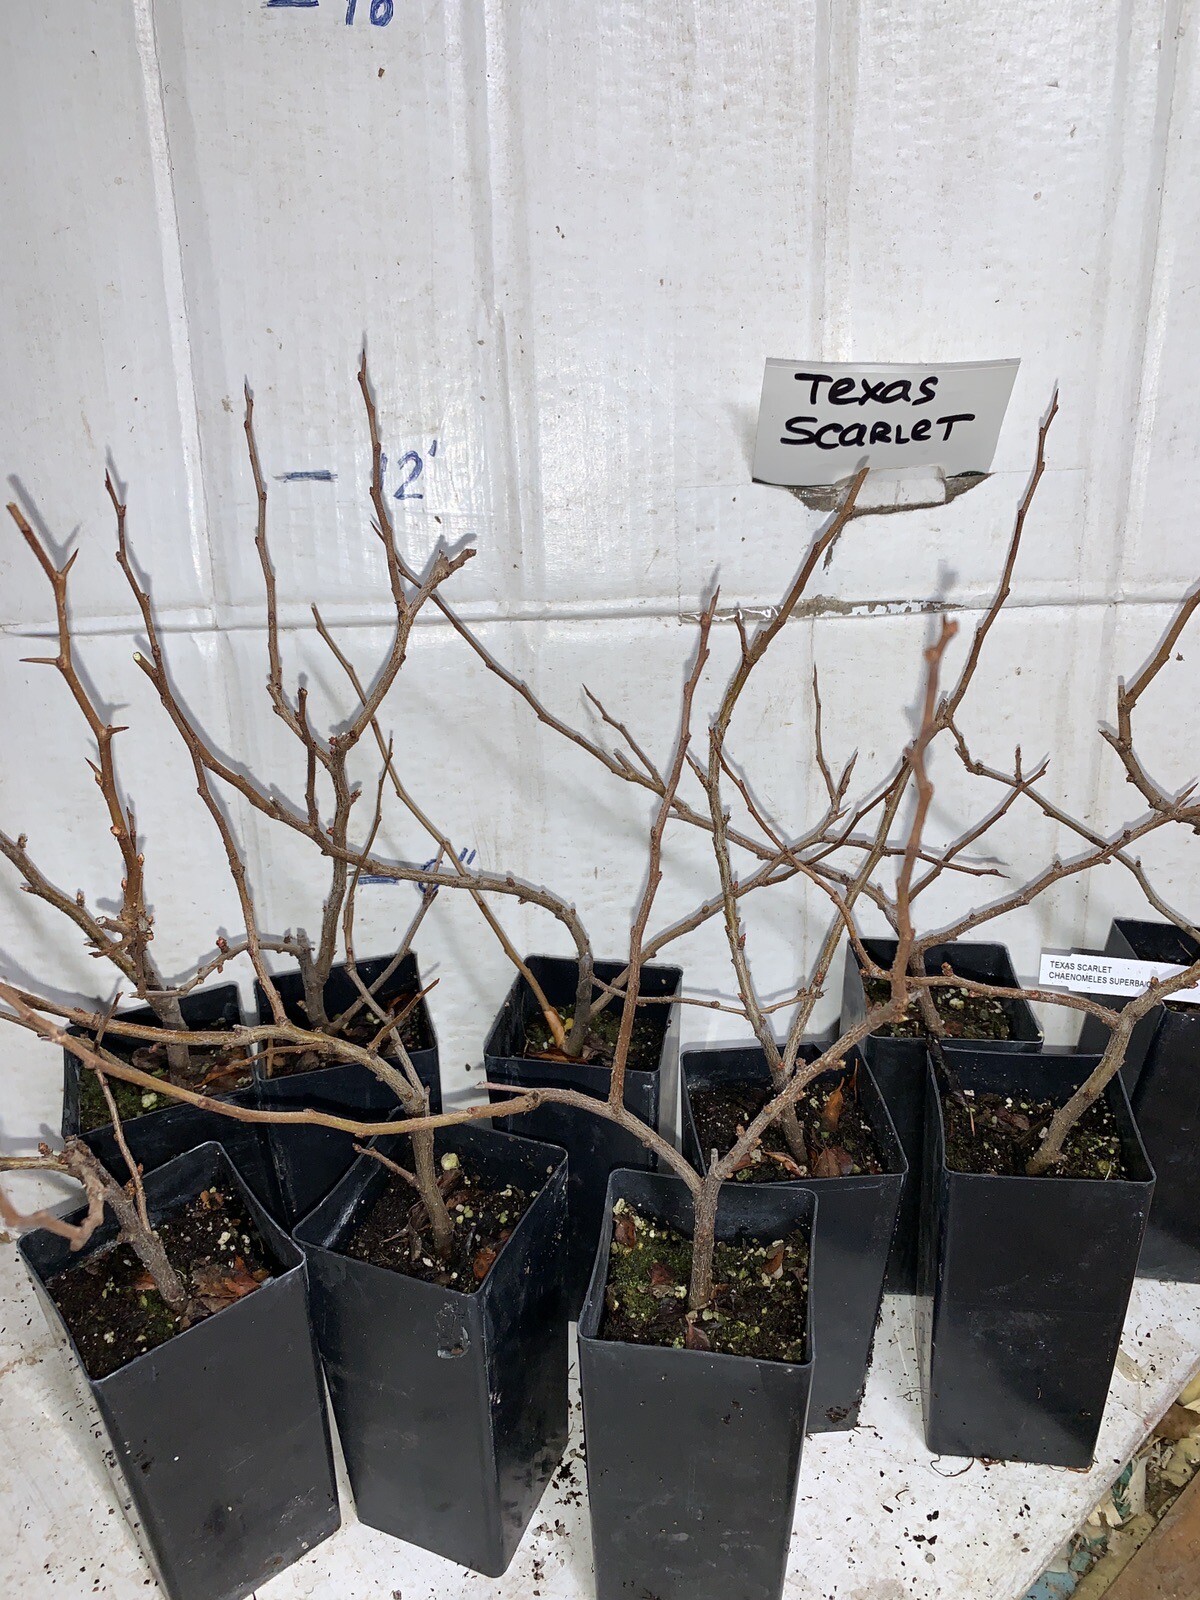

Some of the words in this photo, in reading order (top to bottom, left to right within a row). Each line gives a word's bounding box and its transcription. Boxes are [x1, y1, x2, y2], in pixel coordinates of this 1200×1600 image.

[794, 373, 939, 406] Texas
[1050, 960, 1075, 970] TEXAS
[1077, 963, 1112, 974] SCARLET
[1049, 971, 1107, 984] CHAENOMELES
